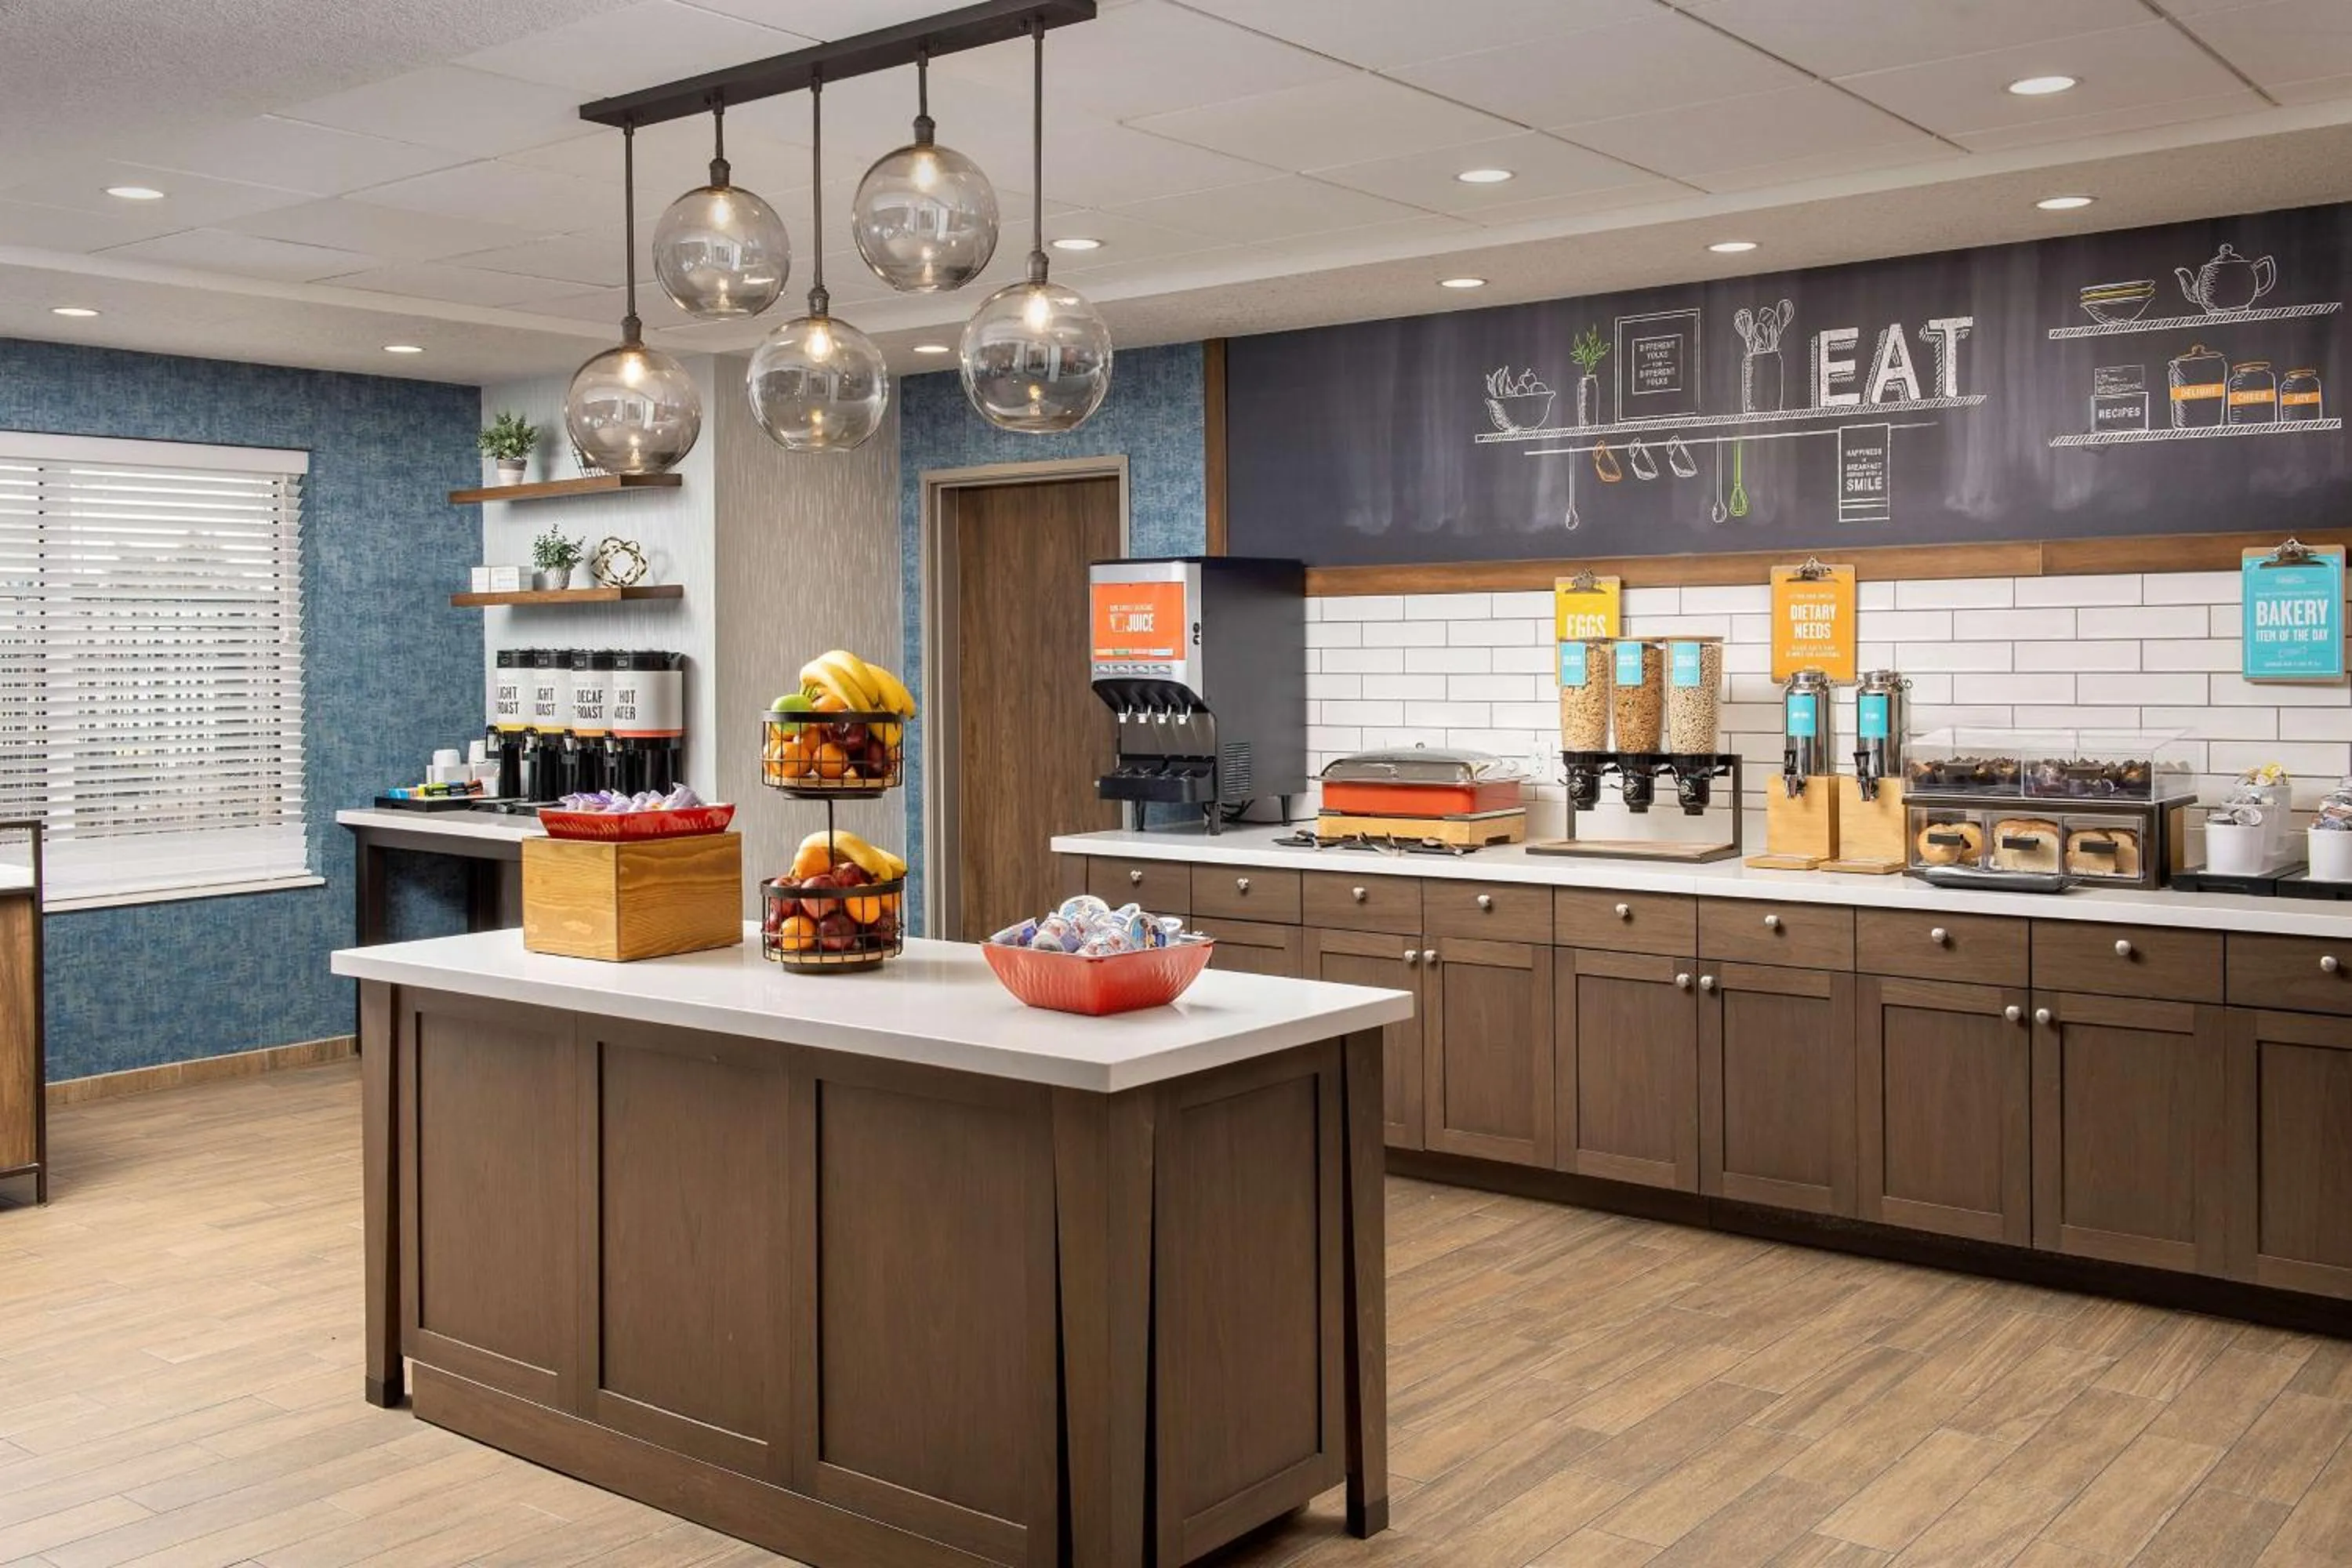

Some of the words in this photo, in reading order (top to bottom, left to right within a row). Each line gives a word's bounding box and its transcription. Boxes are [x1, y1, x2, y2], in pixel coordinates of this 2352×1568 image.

[1812, 316, 1973, 408] EAT
[2180, 387, 2216, 398] DELIGHT
[2237, 394, 2267, 403] CHEER
[2294, 394, 2310, 403] JOY
[2099, 407, 2141, 419] RECIPES
[1846, 477, 1882, 492] SMILE
[1790, 603, 1837, 622] DIETARY
[2256, 598, 2328, 626] BAKERY
[1127, 613, 1154, 632] JUICE
[1566, 614, 1606, 638] EGGS
[1794, 622, 1831, 639] NEEDS
[2256, 630, 2276, 642] ITEM
[2278, 630, 2290, 642] OF
[2293, 630, 2309, 641] THE
[2312, 629, 2328, 641] DAY
[537, 688, 554, 701] IGHT
[576, 689, 603, 703] DECAF
[619, 689, 636, 704] HOT
[535, 703, 556, 716] OAST
[576, 705, 603, 719] ROAST
[614, 706, 636, 720] ATER
